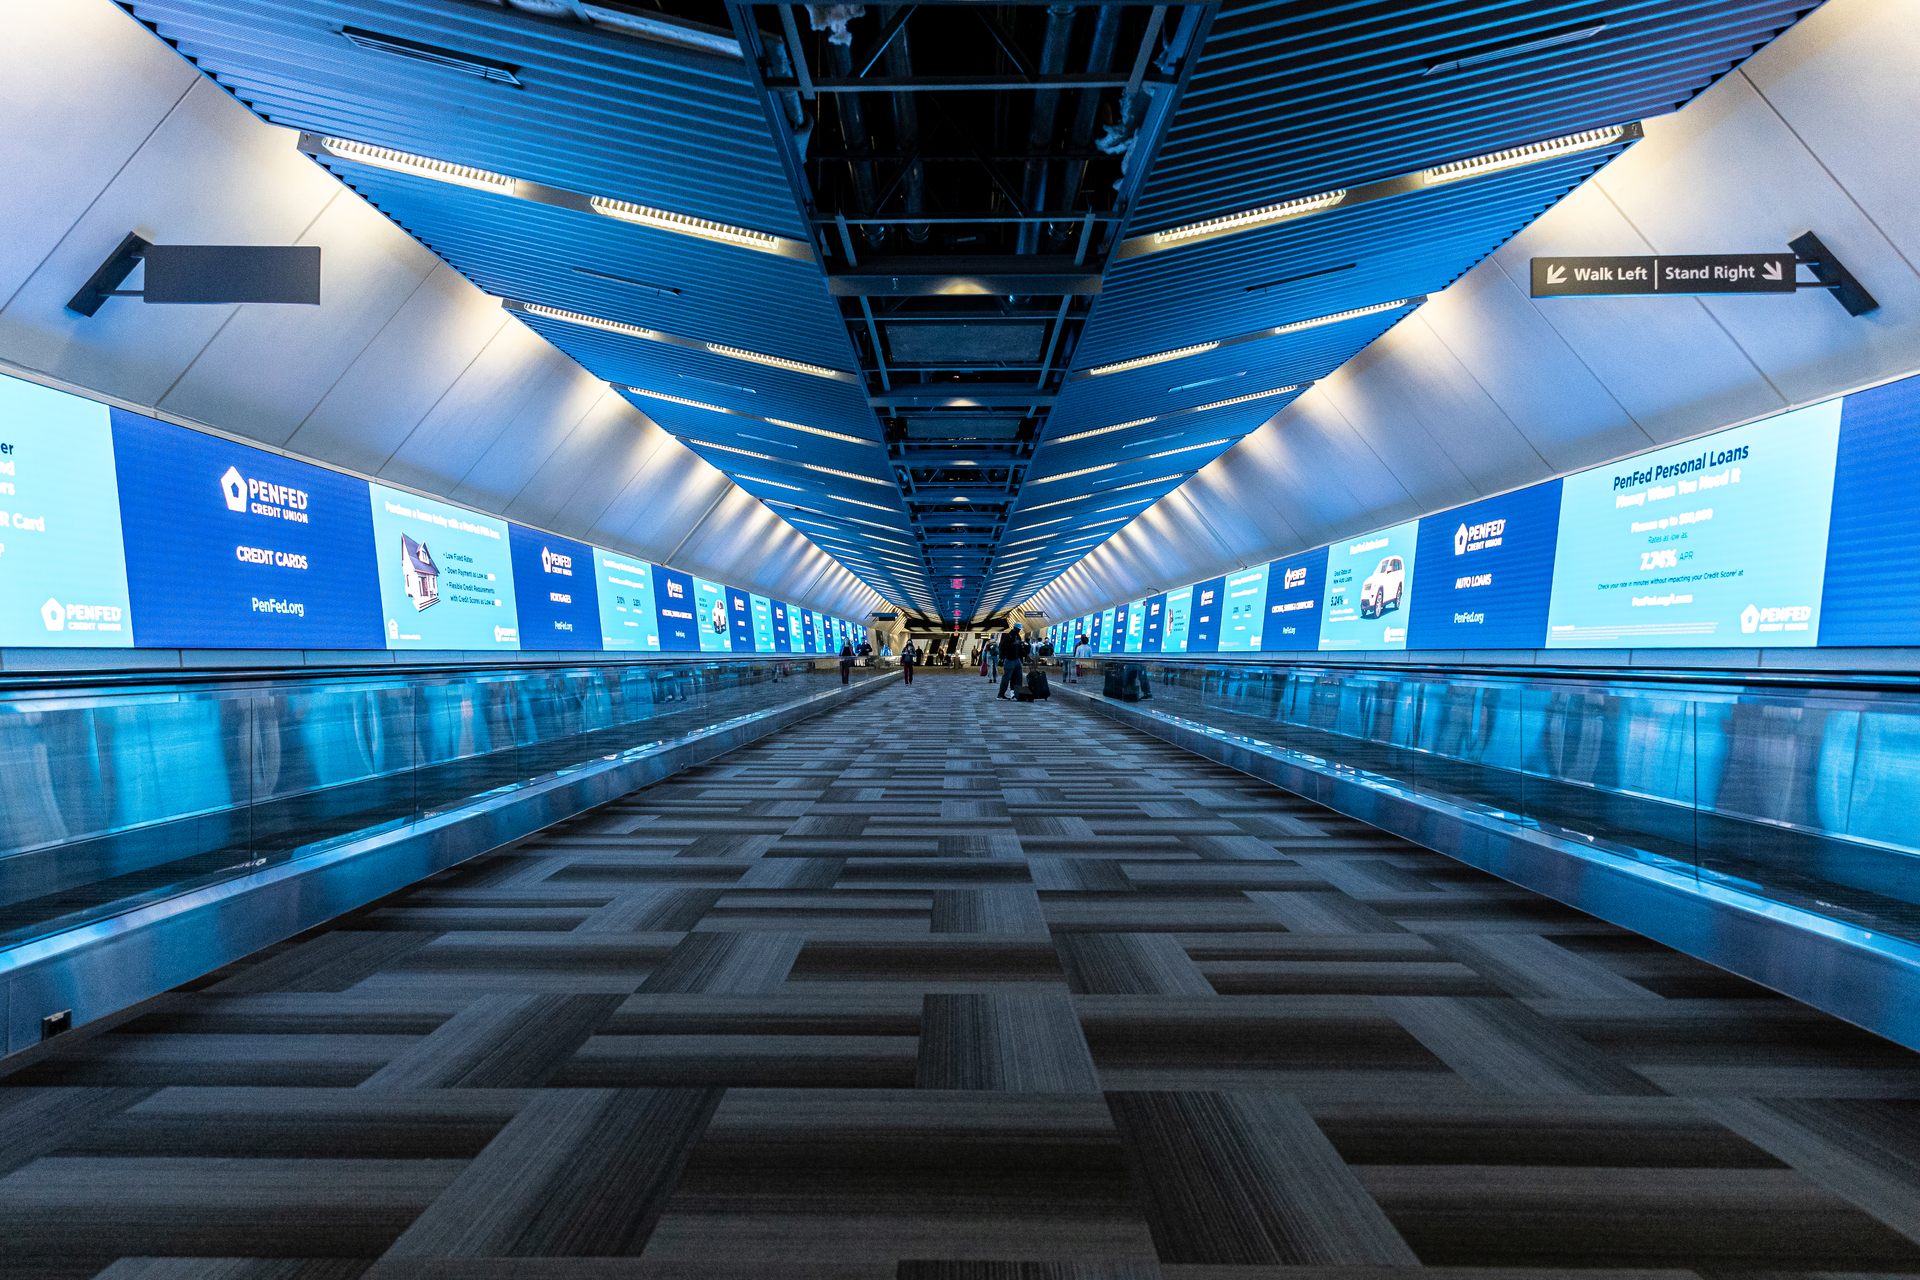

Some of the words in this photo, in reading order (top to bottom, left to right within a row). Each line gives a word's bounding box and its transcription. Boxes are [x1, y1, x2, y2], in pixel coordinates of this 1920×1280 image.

[1574, 267, 1613, 281] Walk
[1617, 266, 1648, 280] Left
[1665, 265, 1709, 279] Stand
[1714, 264, 1756, 282] Right
[1613, 467, 1652, 491] PenFed
[1655, 452, 1706, 480] Personal
[1709, 445, 1749, 467] Loans
[248, 478, 308, 510] PENFED
[1616, 492, 1646, 509] Money
[1647, 485, 1676, 501] When
[1678, 480, 1697, 495] You
[1699, 469, 1729, 490] Need
[1730, 467, 1741, 483] It
[12, 513, 45, 532] Card
[251, 503, 281, 518] CREDIT
[282, 509, 308, 524] UNION
[1659, 519, 1669, 529] up
[1669, 516, 1678, 526] to
[1468, 519, 1506, 541] PENFED
[1648, 535, 1662, 544] Rates
[236, 545, 273, 565] CREDIT
[275, 551, 308, 570] CARDS
[550, 552, 572, 568] PENFED
[1640, 548, 1677, 571] 7.74%
[1679, 551, 1693, 561] APR
[1455, 576, 1471, 589] AUTO
[1471, 573, 1492, 587] LOANS
[1668, 575, 1691, 583] impacting
[1703, 571, 1719, 579] Credit
[66, 604, 122, 621] PENFED
[252, 597, 304, 617] PenFed.org
[1760, 606, 1812, 622] PENFED
[1454, 611, 1484, 624] PenFed.org
